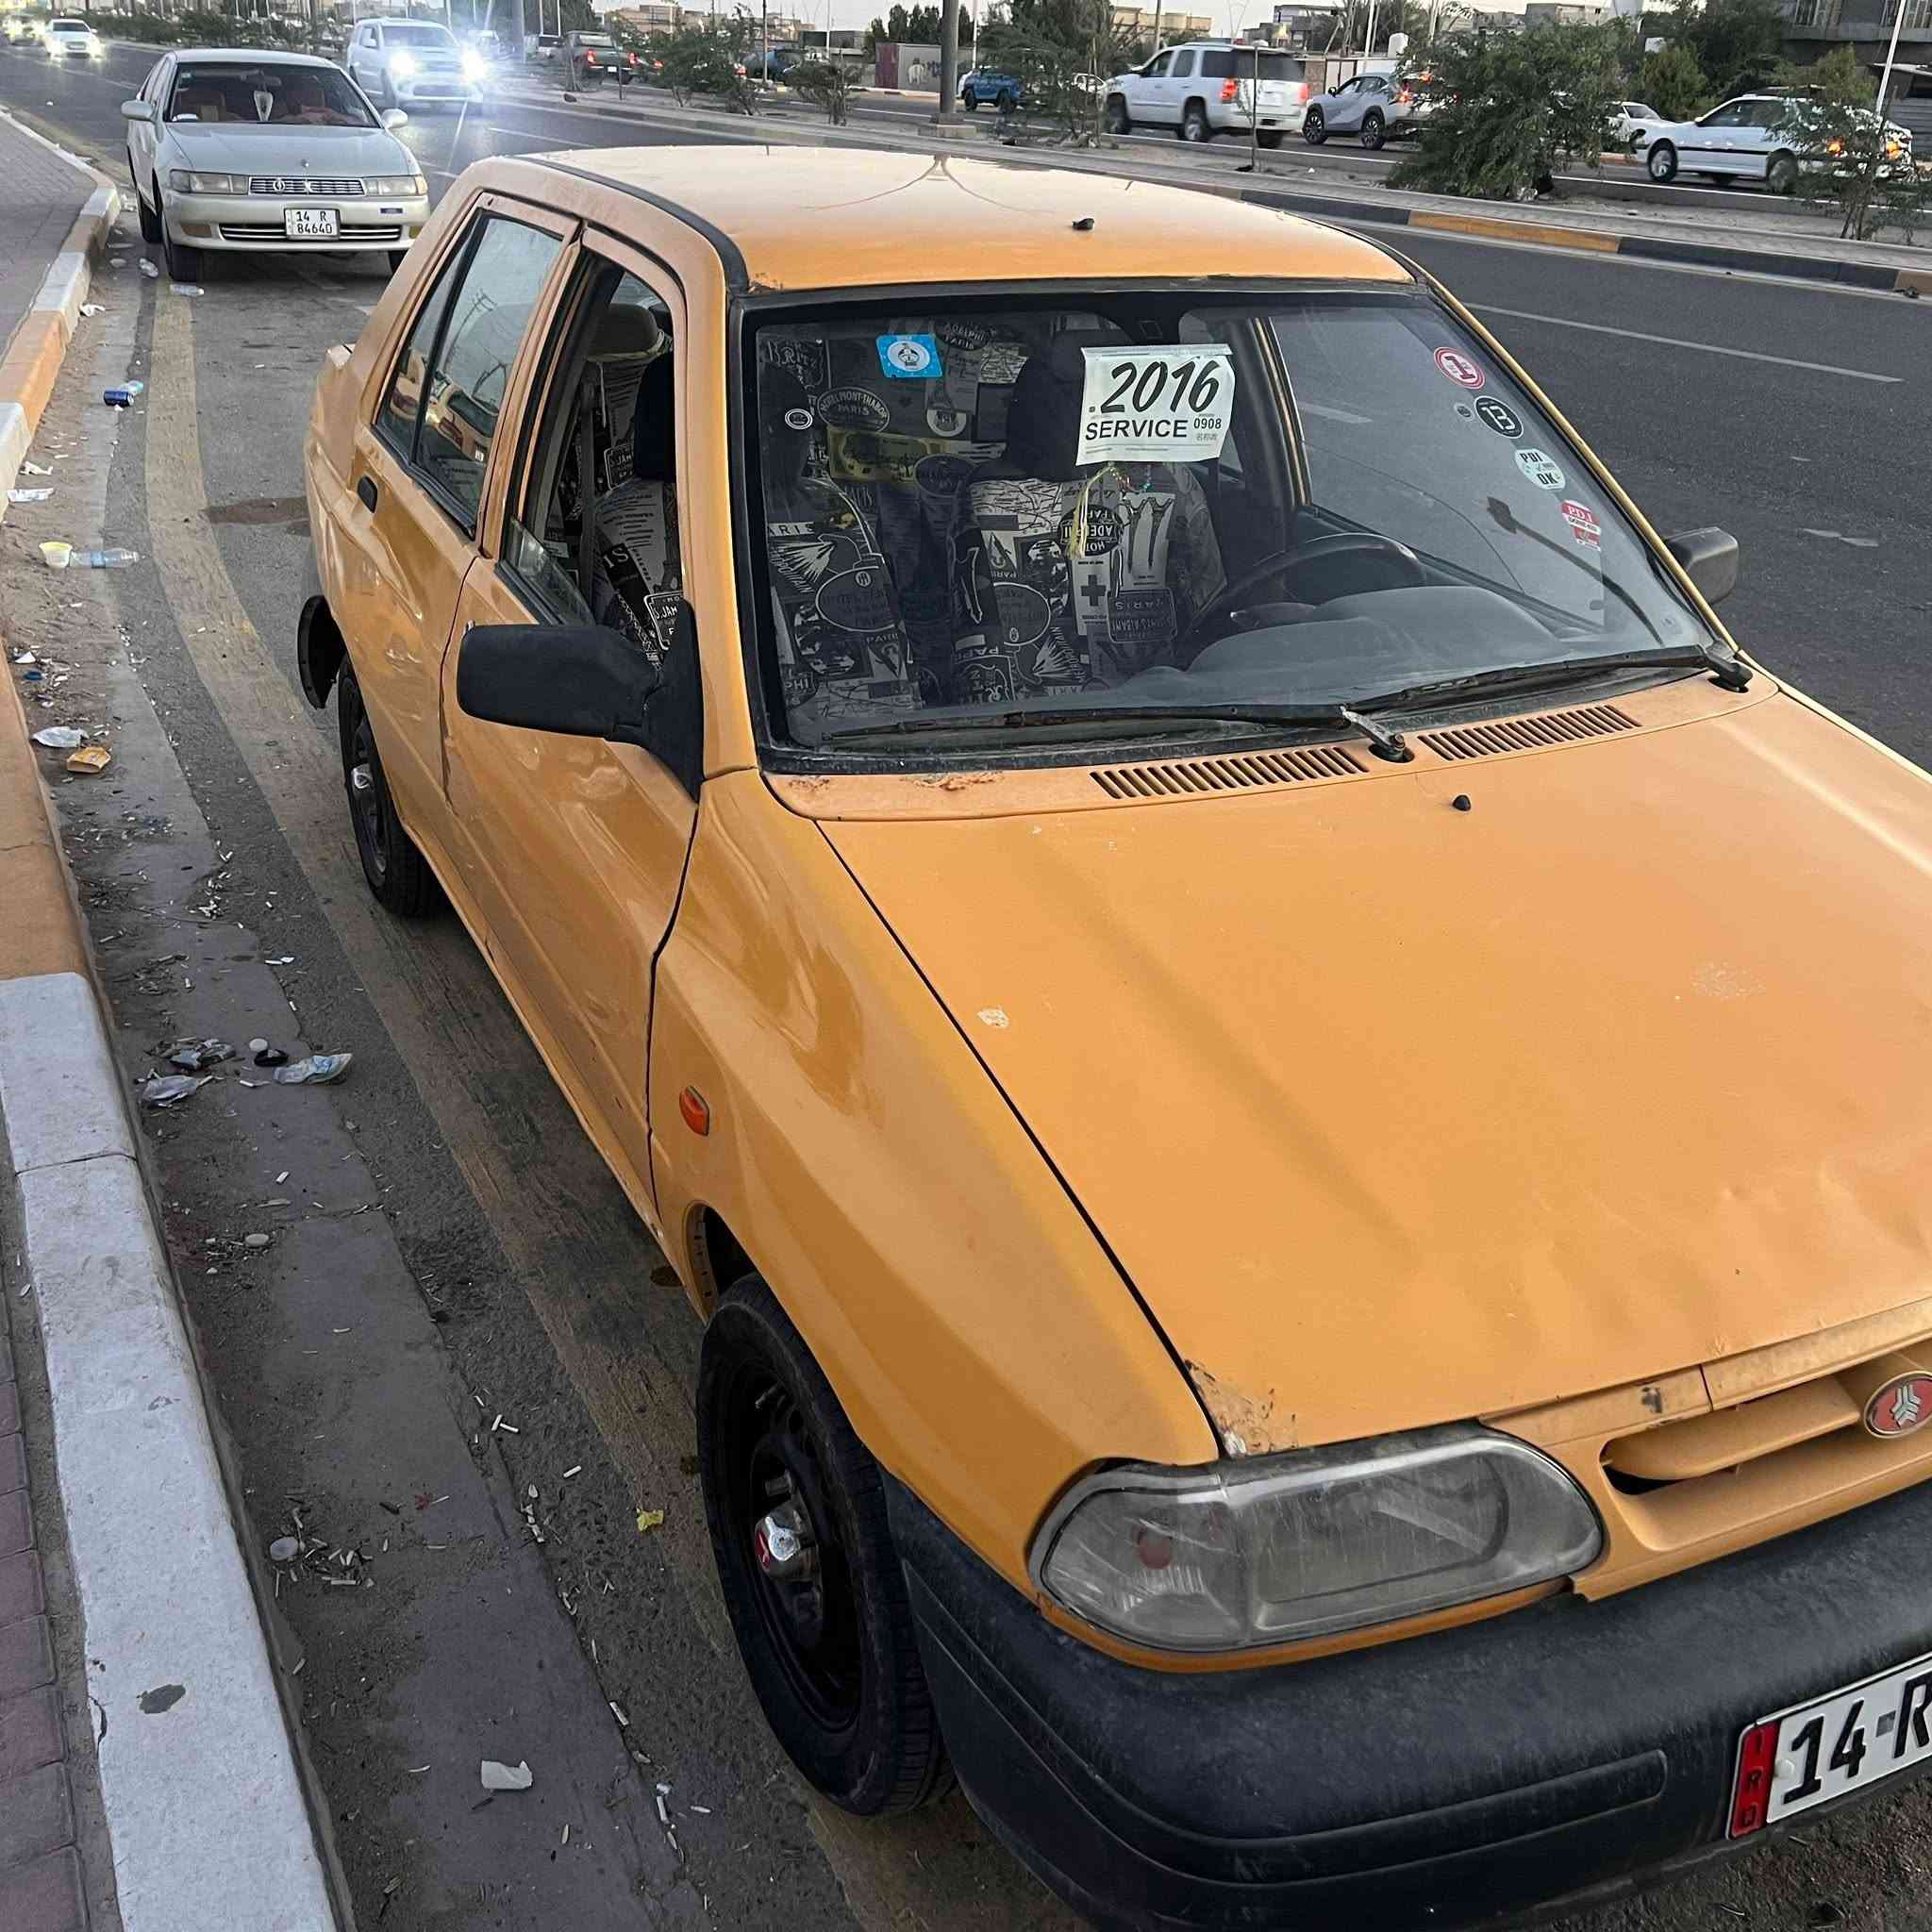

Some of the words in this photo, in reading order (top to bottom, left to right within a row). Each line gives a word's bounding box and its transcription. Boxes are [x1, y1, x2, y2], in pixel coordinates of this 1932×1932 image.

[296, 211, 310, 222] 14
[320, 210, 326, 222] R
[297, 223, 332, 234] 84640
[1100, 360, 1221, 413] 2016
[1085, 419, 1189, 441] SERVICE
[1193, 418, 1222, 429] 0908
[1519, 453, 1543, 463] PDI
[1536, 473, 1558, 485] OK
[1781, 1699, 1866, 1806] 14
[1893, 1674, 1932, 1758] R
